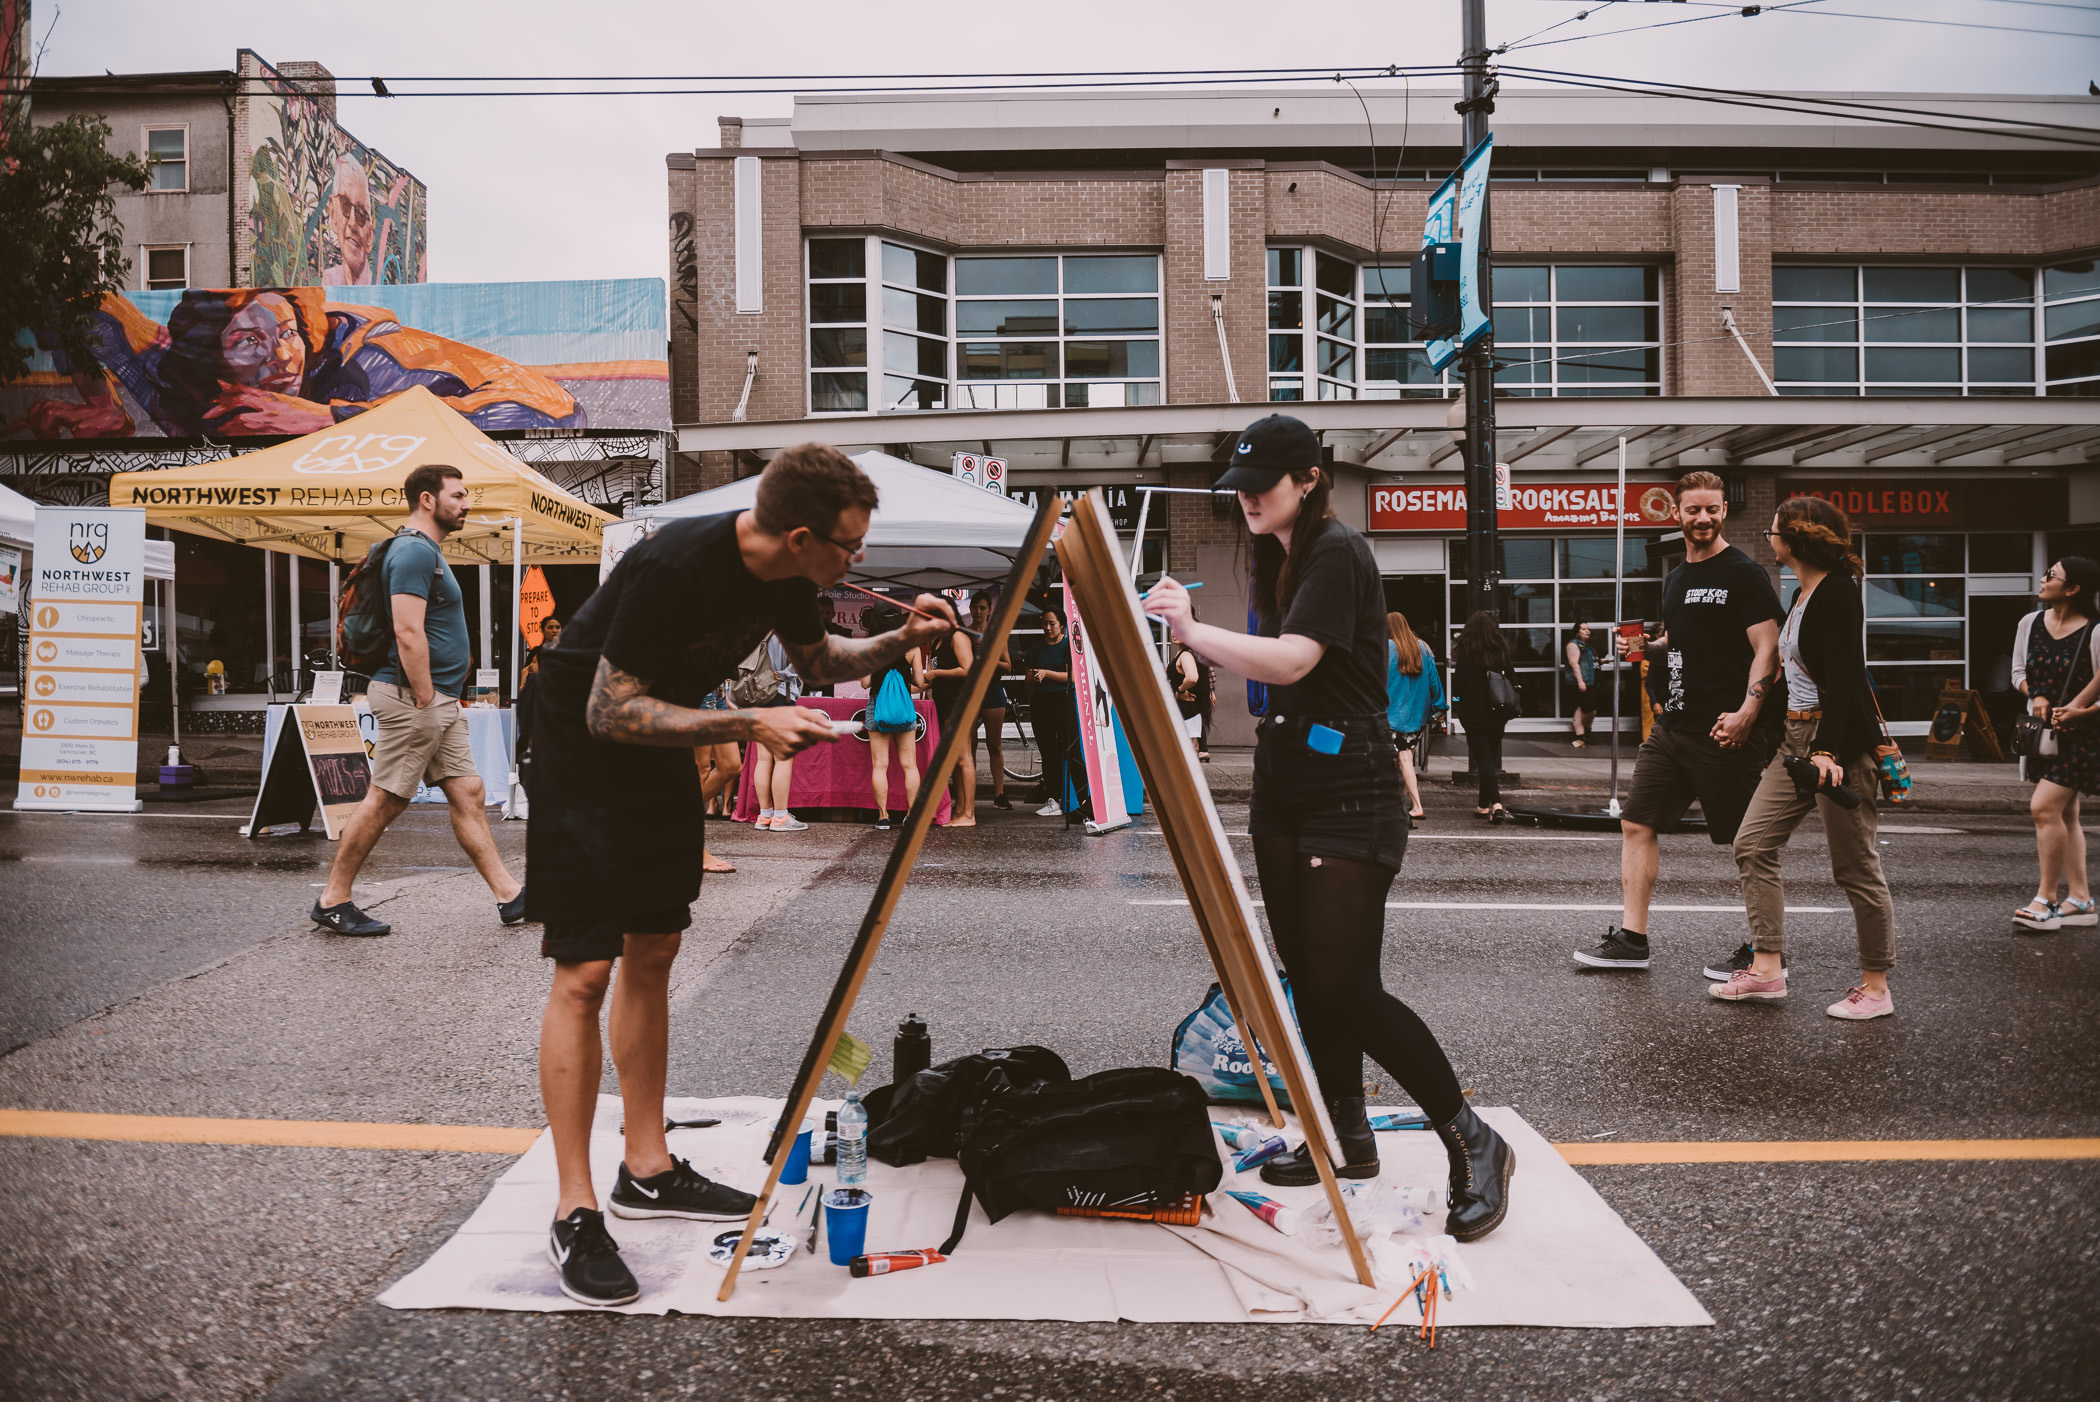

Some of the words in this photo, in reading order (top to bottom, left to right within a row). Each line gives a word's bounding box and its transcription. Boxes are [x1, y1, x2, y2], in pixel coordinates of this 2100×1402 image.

[131, 486, 281, 505] NORTHWEST
[289, 487, 373, 506] REHAB
[1375, 489, 1467, 512] ROSEMA
[530, 491, 593, 531] NORTHWEST
[1543, 511, 1598, 525] Amazing
[1599, 511, 1641, 522] Baels
[42, 570, 131, 582] NORTHWEST
[41, 582, 80, 593] REHAB
[82, 583, 124, 594] GROUP
[520, 591, 549, 604] PREPARE
[824, 590, 842, 599] Pole
[843, 590, 871, 600] Studio
[530, 606, 539, 618] TO
[314, 720, 357, 729] NORTHWEST
[40, 773, 114, 783] www.nwrehab.ca
[311, 757, 357, 797] PRIZES
